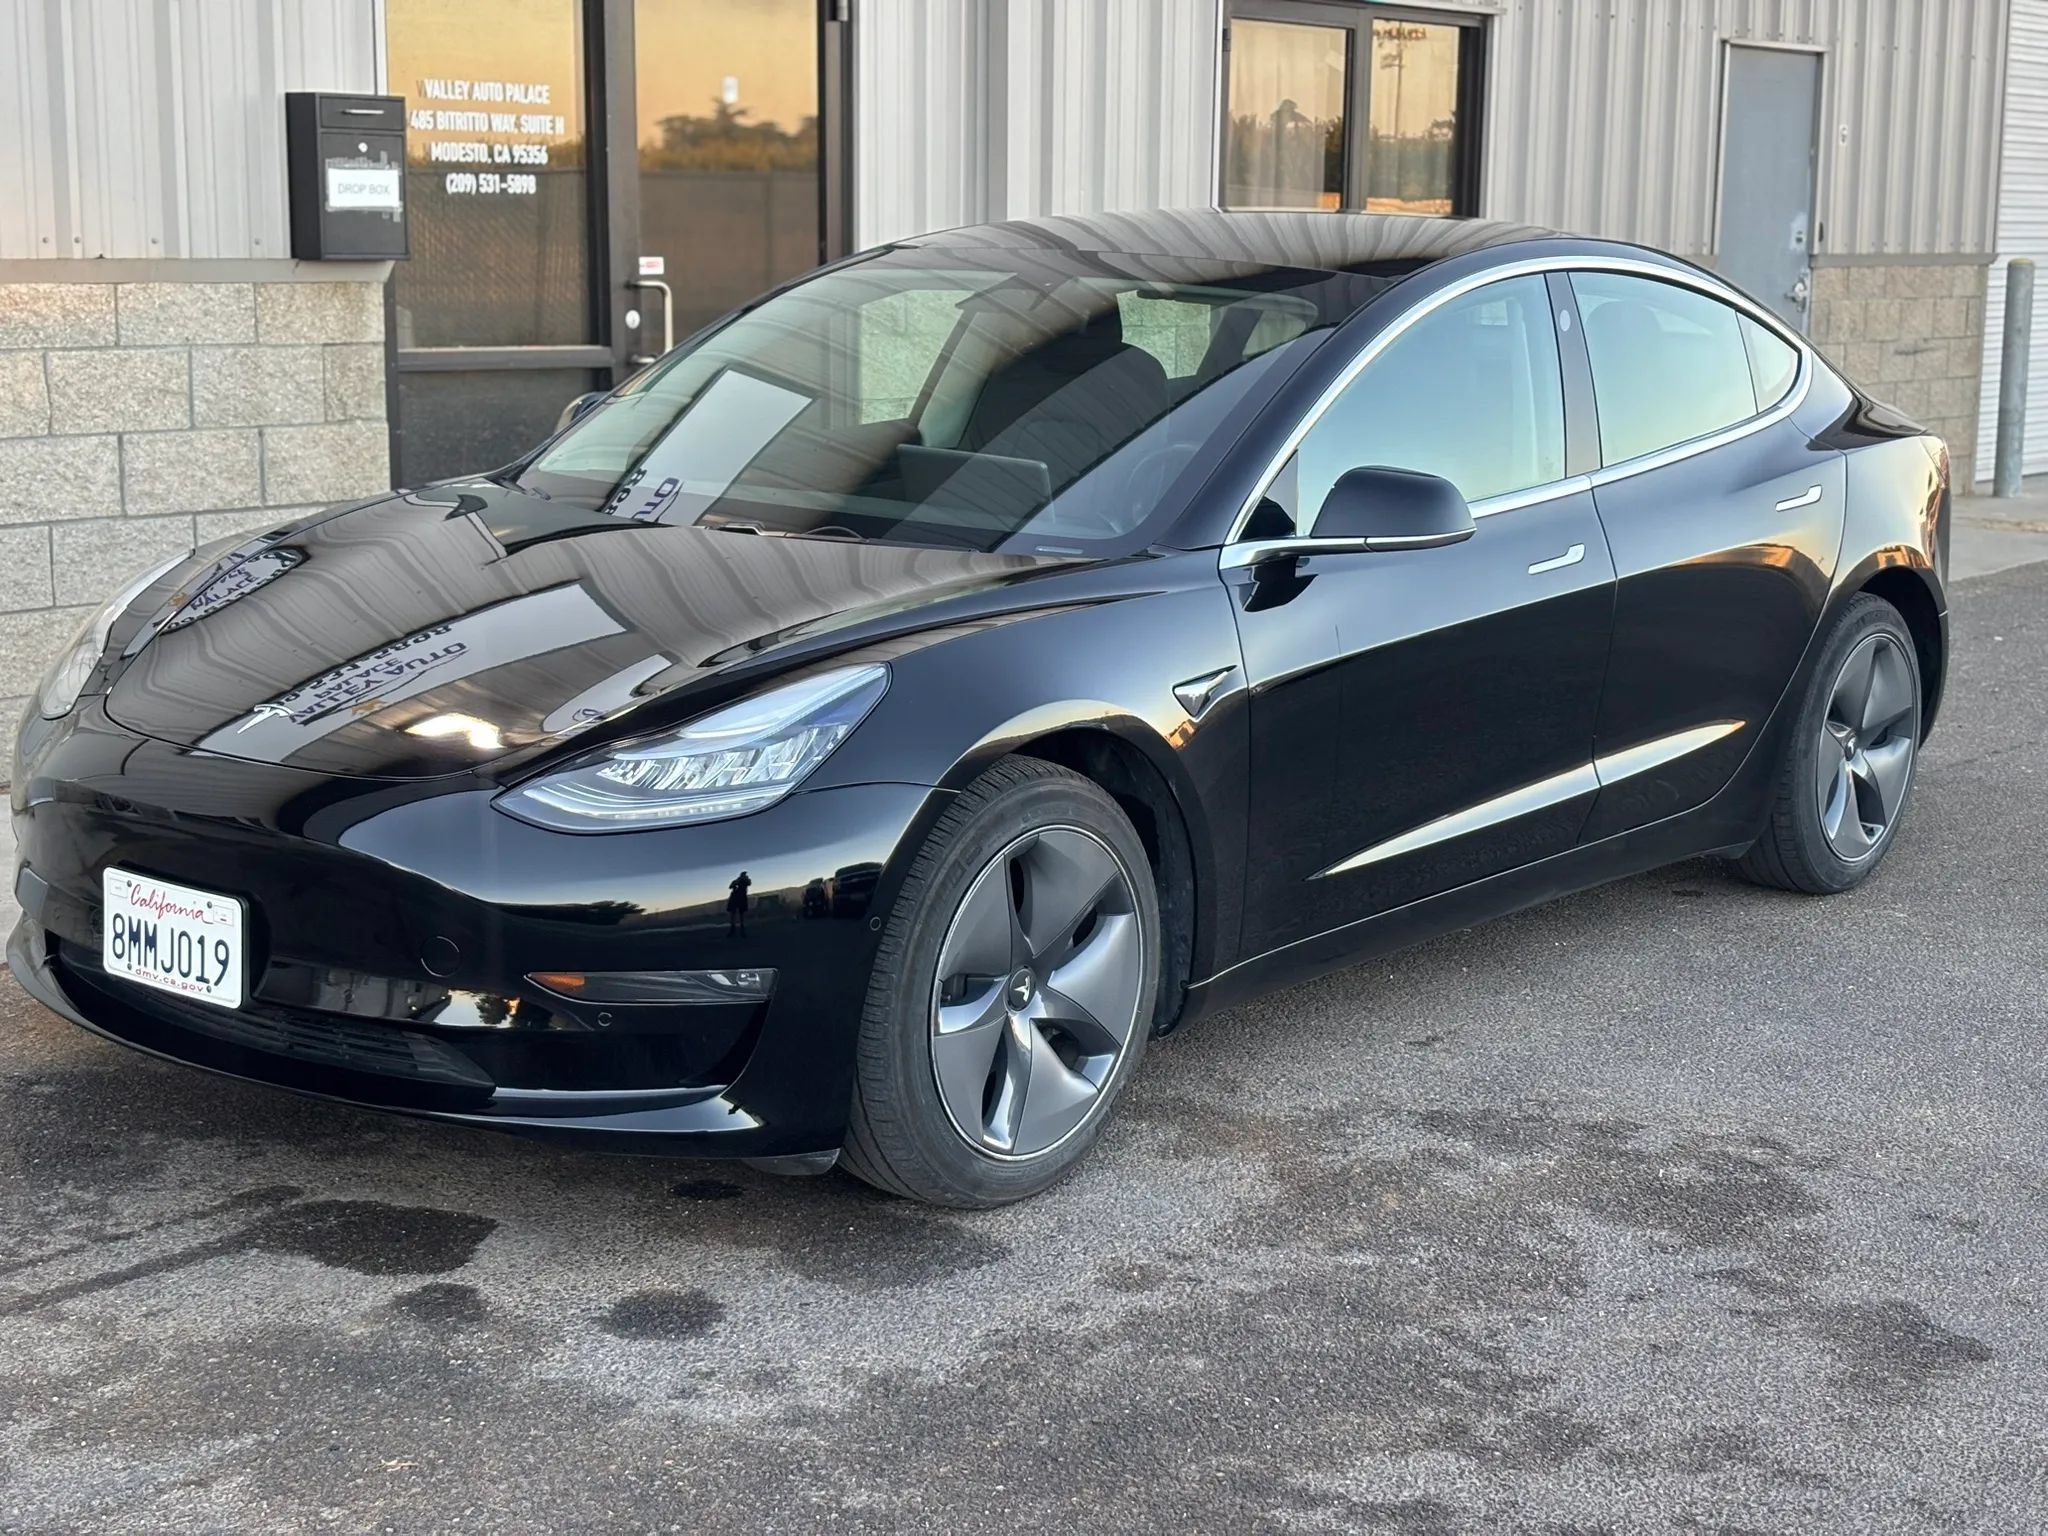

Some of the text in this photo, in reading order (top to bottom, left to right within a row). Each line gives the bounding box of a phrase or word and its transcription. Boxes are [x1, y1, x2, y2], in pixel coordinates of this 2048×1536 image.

[424, 79, 551, 104] VALLEY AUTO PALACE
[411, 110, 434, 130] 485
[436, 111, 489, 133] BITRITTO
[520, 114, 554, 135] SUITE
[555, 115, 565, 135] H
[430, 142, 548, 164] MODESTO, CA 95356
[338, 183, 391, 194] DROP BOX
[446, 172, 477, 196] (209)
[131, 884, 214, 924] California
[112, 913, 230, 986] 8MMJ019
[136, 969, 204, 992] dmv.ca.gov
